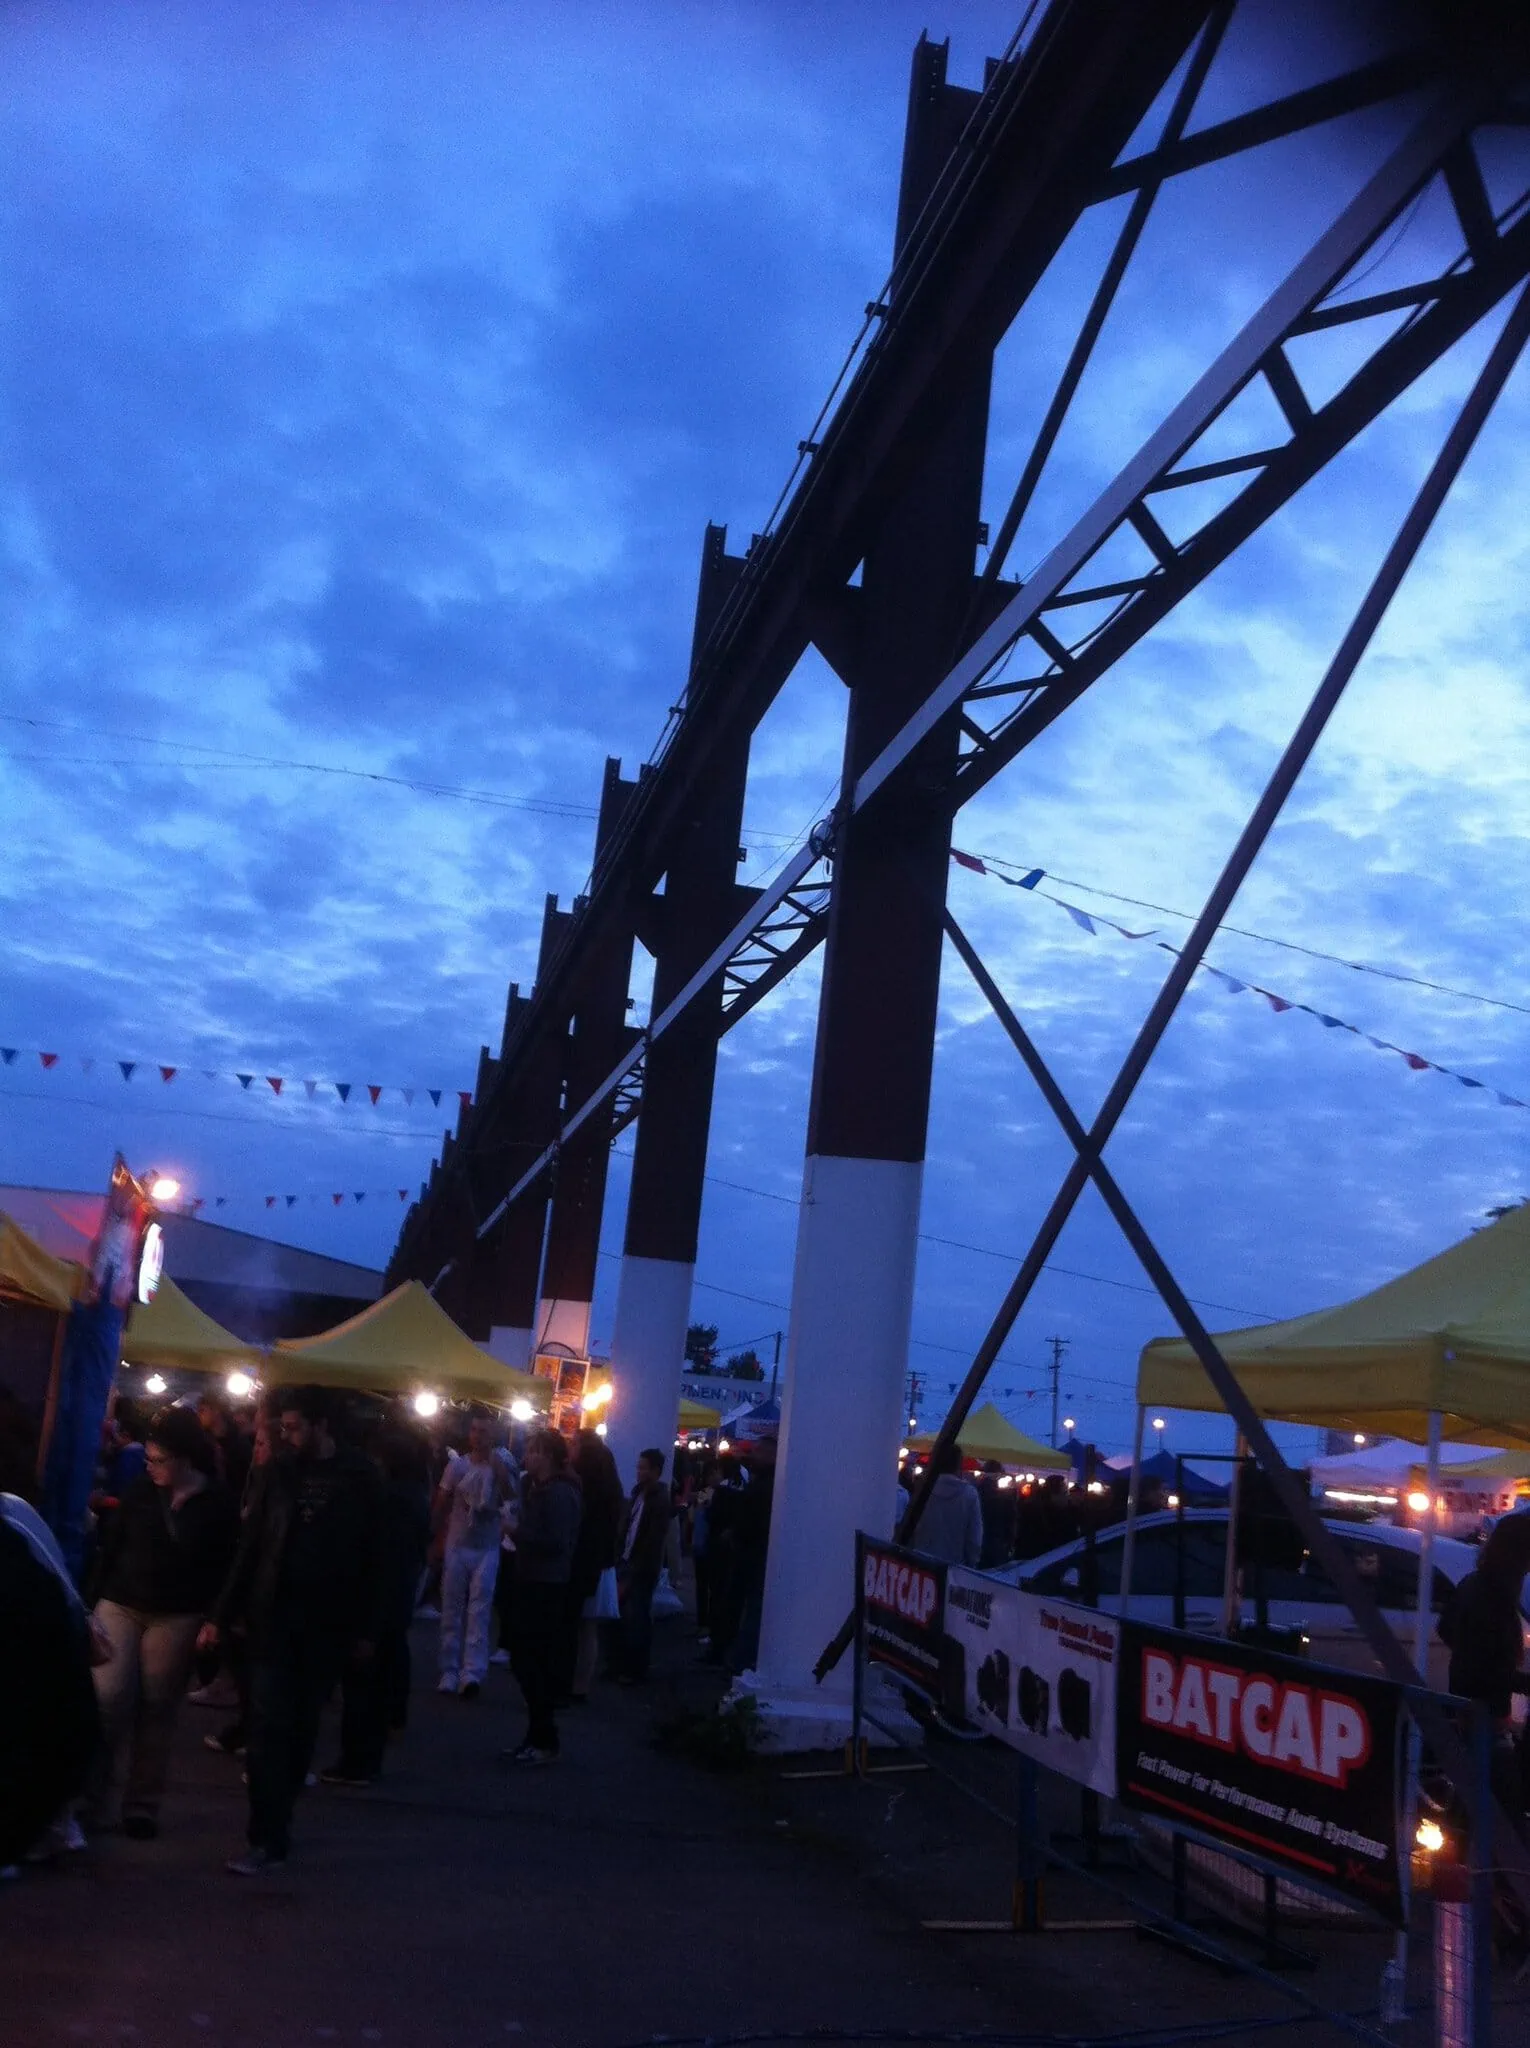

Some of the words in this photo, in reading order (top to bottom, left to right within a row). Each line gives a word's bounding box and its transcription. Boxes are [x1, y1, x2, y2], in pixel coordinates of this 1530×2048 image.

[863, 1552, 938, 1627] BATCAP
[1143, 1650, 1368, 1783] BATCAP
[1137, 1751, 1158, 1775] Fast
[1158, 1759, 1192, 1785] Power
[1209, 1779, 1287, 1822] Performance
[1285, 1808, 1323, 1837] Audio
[1323, 1821, 1390, 1861] Systems
